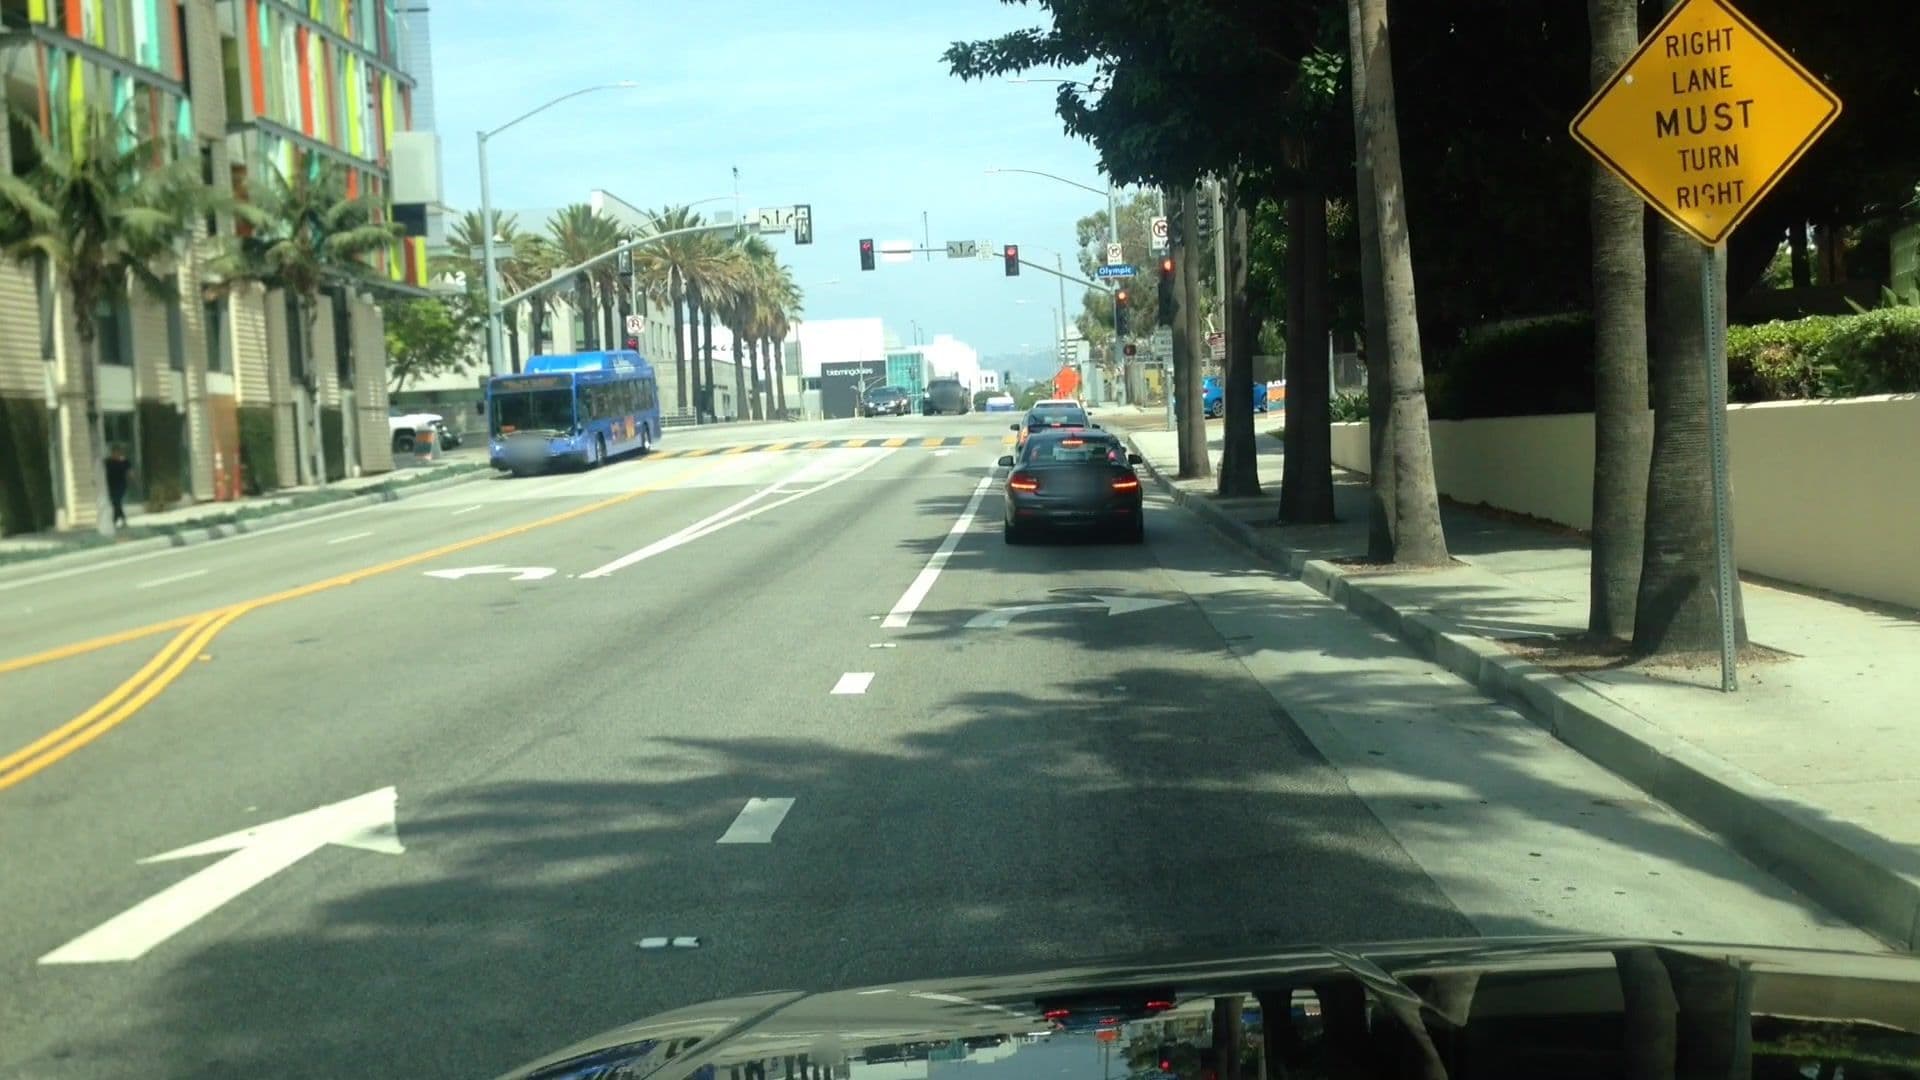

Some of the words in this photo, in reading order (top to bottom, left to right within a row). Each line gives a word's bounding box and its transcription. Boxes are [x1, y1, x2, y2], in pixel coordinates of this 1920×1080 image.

[1665, 28, 1733, 58] RIGHT
[1673, 65, 1733, 94] LANE
[1656, 100, 1754, 138] MUST
[1678, 144, 1739, 172] TURN
[1677, 180, 1744, 209] RIGHT
[1099, 266, 1132, 275] Olympic
